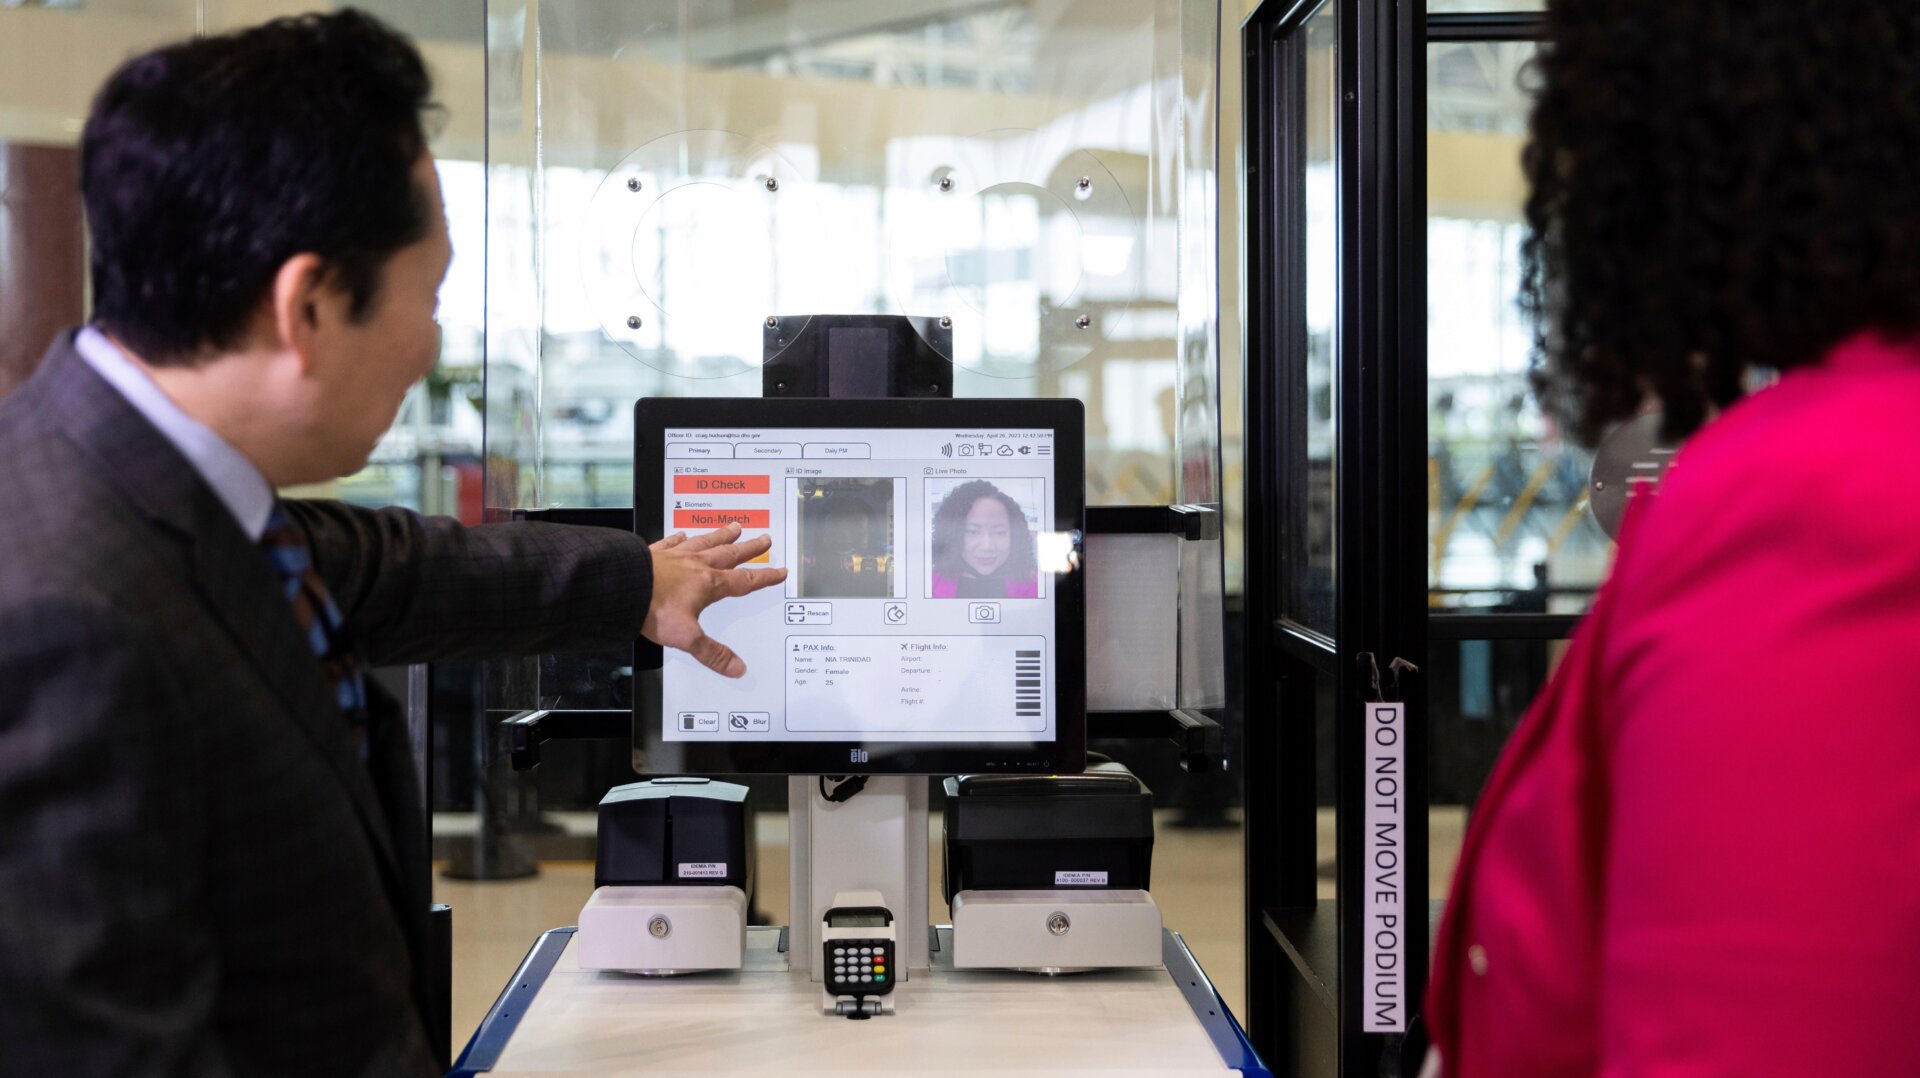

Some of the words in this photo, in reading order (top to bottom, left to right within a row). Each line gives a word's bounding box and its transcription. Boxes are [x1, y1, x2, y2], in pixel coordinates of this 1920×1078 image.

[696, 480, 708, 489] ID
[712, 480, 745, 489] Check
[692, 515, 750, 524] Non-Match
[1375, 708, 1397, 746] DO
[1375, 757, 1397, 814] NOT
[1375, 823, 1397, 903] MOVE
[1375, 915, 1397, 1026] PODIUM
